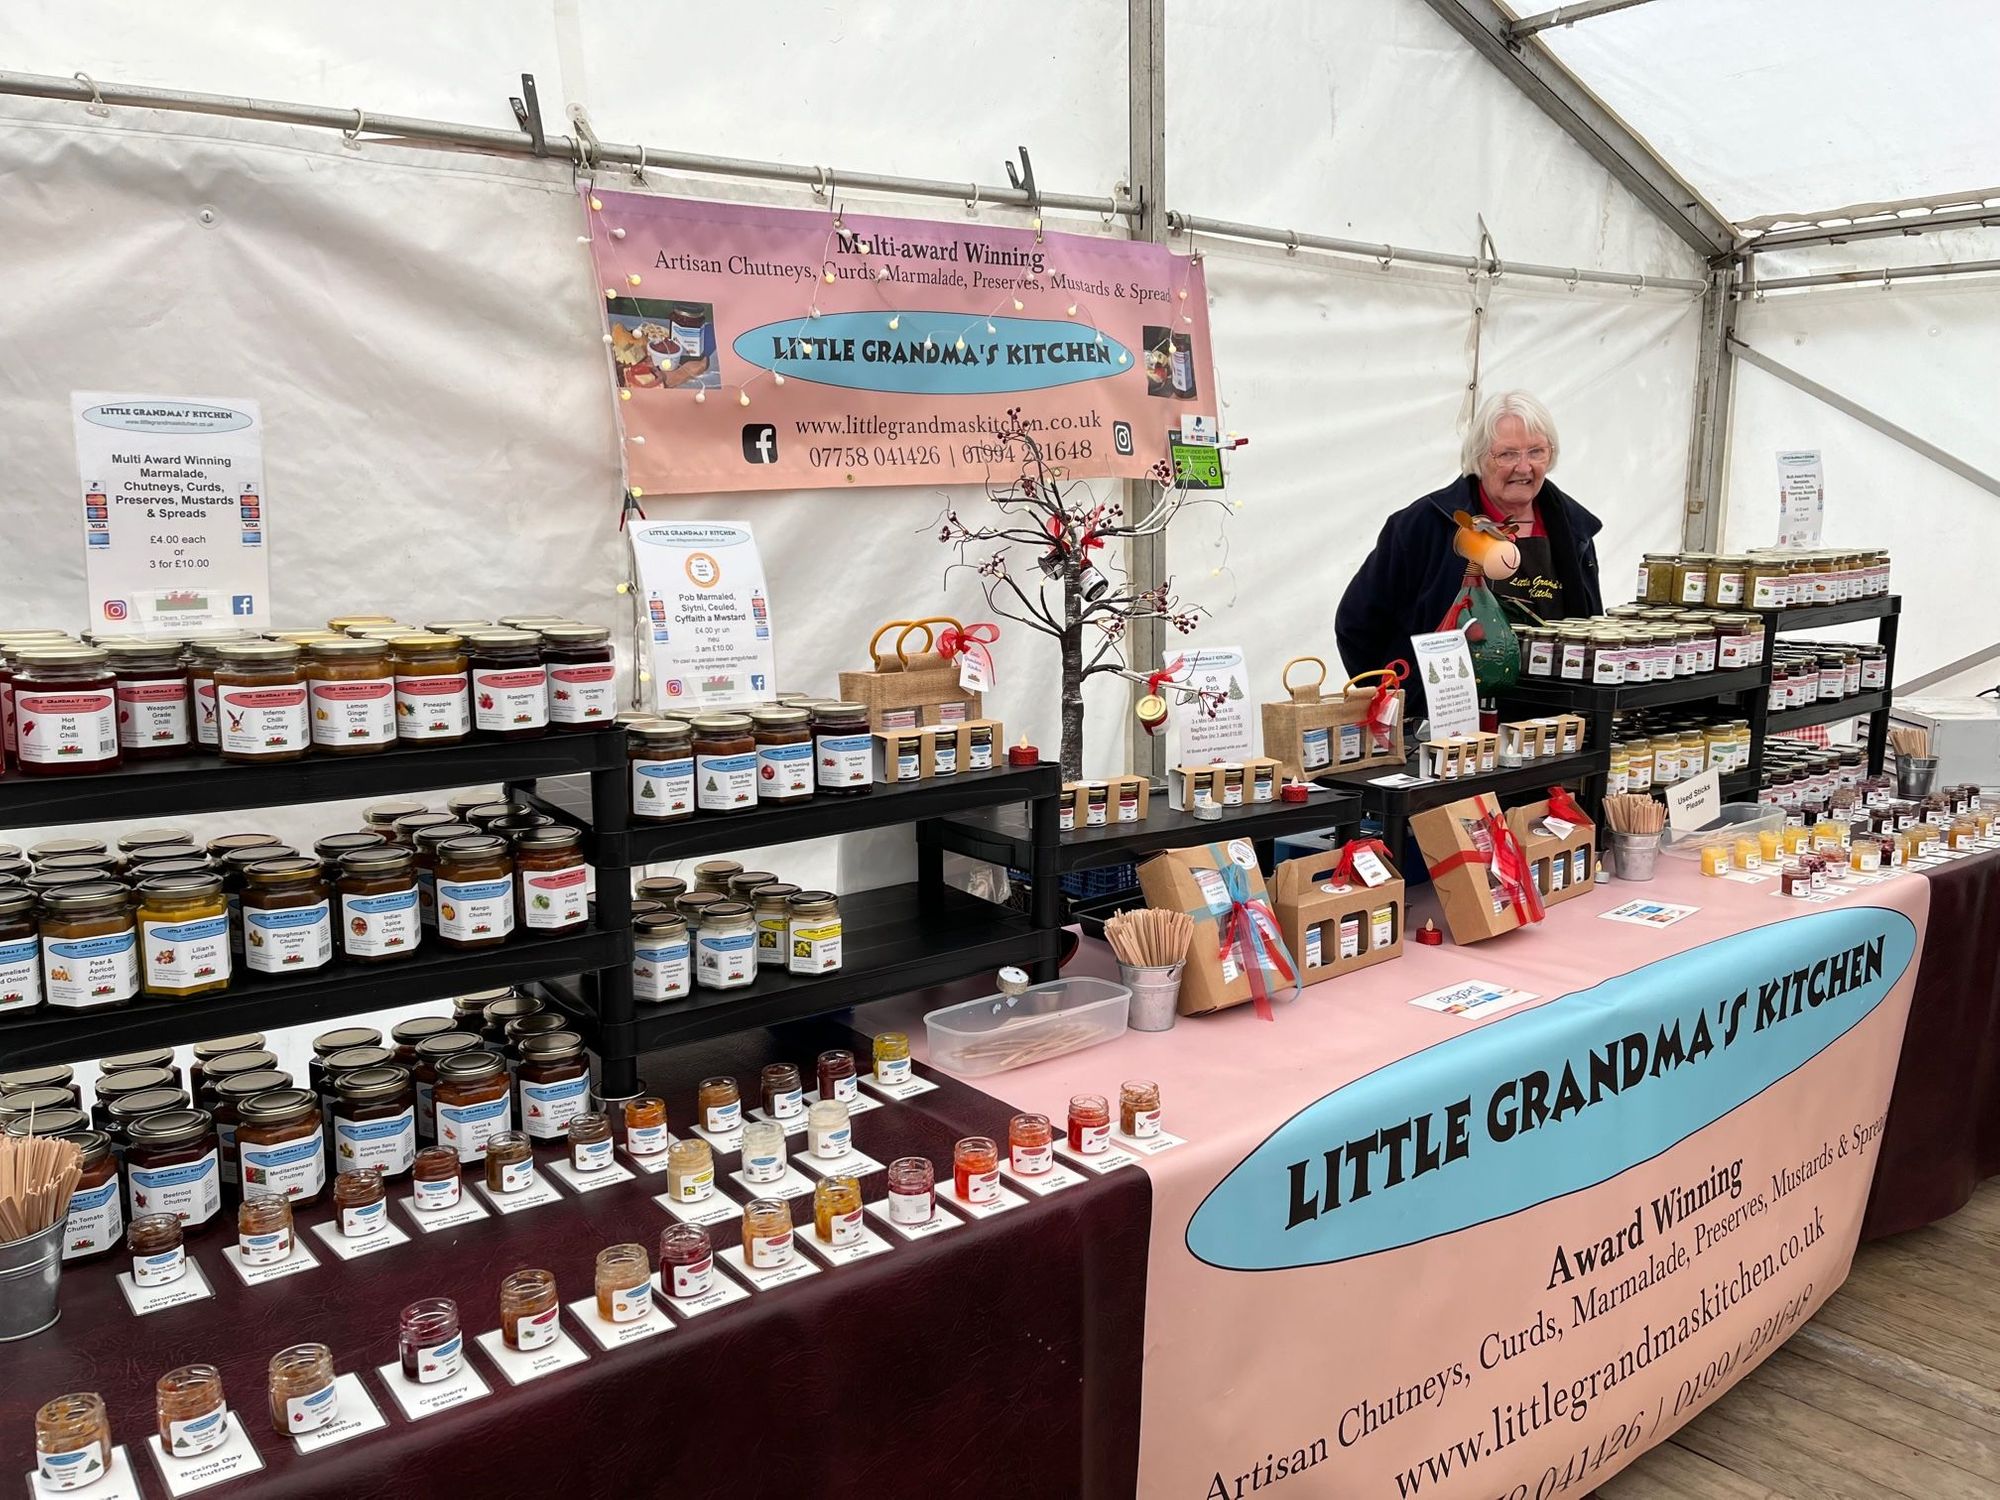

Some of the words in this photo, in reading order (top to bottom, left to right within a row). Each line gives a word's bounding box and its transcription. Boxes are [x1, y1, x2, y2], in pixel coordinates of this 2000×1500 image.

[964, 242, 1045, 274] Winning
[655, 251, 722, 273] Artisan
[728, 256, 817, 283] Chutneys,
[885, 265, 968, 289] Marmalade,
[973, 272, 1045, 293] Preserves,
[1051, 274, 1110, 296] Mustards
[1114, 286, 1125, 298] &
[772, 337, 855, 363] LITTLE
[862, 338, 1000, 367] GRANDMA'S
[1007, 338, 1111, 366] KITCHEN
[133, 409, 189, 418] GRANDMA'S
[192, 411, 232, 419] KITCHEN
[809, 448, 869, 468] 07758
[874, 446, 940, 467] 041426
[963, 444, 1016, 465] 01994
[1022, 440, 1092, 463] 231648
[112, 455, 141, 465] Multi
[144, 455, 181, 465] Award
[184, 456, 231, 467] Winning
[140, 469, 207, 479] Marmalade,
[1211, 468, 1216, 477] 5
[124, 482, 184, 493] Chutneys,
[187, 483, 225, 493] Curds,
[116, 496, 178, 506] Preserves,
[182, 496, 234, 505] Mustards
[147, 510, 155, 518] &
[159, 510, 206, 520] Spreads
[150, 536, 179, 544] £4.00
[182, 536, 206, 544] each
[159, 560, 173, 568] for
[175, 560, 209, 568] £10.00
[679, 594, 694, 602] Pob
[675, 615, 705, 624] Cyffaith
[579, 688, 605, 696] Cranberry
[507, 693, 535, 702] Raspberry
[147, 705, 176, 713] Weapons
[423, 701, 452, 710] Pineapple
[347, 710, 368, 718] Ginger
[262, 724, 289, 732] Chutney
[60, 731, 79, 739] Chilli
[667, 780, 690, 788] Christmas
[1678, 792, 1693, 805] Used
[1694, 784, 1711, 798] Sticks
[1686, 797, 1705, 812] Please
[469, 911, 493, 919] Chutney
[471, 906, 490, 914] Mango
[383, 913, 402, 921] Indian
[385, 920, 402, 928] Spice
[382, 925, 406, 934] Chutney
[272, 930, 311, 940] Ploughman's
[280, 937, 305, 946] Chutney
[192, 944, 215, 954] Lilian's
[190, 951, 217, 961] Piccalilli
[90, 959, 105, 967] Pear
[89, 965, 115, 975] Apricot
[7, 976, 28, 984] Onion
[88, 972, 117, 982] Chutney
[1285, 1095, 1472, 1232] LITTLE
[1487, 993, 1748, 1145] GRANDMA'S
[1754, 935, 1886, 1033] KITCHEN
[375, 1147, 397, 1155] Chutney
[269, 1162, 313, 1177] Mediterranean
[279, 1171, 305, 1182] Chutney
[163, 1189, 192, 1199] Beetroot
[164, 1196, 191, 1206] Chutney
[79, 1213, 104, 1224] Tomato
[1547, 1205, 1645, 1292] Award
[1651, 1155, 1745, 1239] Winning
[67, 1223, 95, 1233] Chutney
[248, 1258, 310, 1278] Mediterranean
[264, 1265, 301, 1278] Chutney
[143, 1300, 169, 1310] Spicy
[170, 1292, 197, 1305] Apple
[150, 1291, 187, 1303] Grumpe
[685, 1289, 727, 1307] Raspberry
[1206, 1437, 1329, 1500] Artisan
[1337, 1359, 1472, 1450] Chutneys,
[1479, 1309, 1564, 1373] Curds,
[1570, 1243, 1692, 1329] Marmalade,
[1694, 1191, 1769, 1258] Preserves,
[1771, 1142, 1834, 1200] Mustards
[1838, 1134, 1849, 1159] &
[618, 1322, 647, 1336] Mango
[619, 1325, 656, 1342] Chutney
[1395, 1207, 1826, 1499] www.littlegrandmaskitchen.co.uk
[418, 1385, 468, 1406] Cranberry
[432, 1394, 463, 1408] Sauce
[316, 1420, 362, 1440] Humbug
[180, 1463, 219, 1479] Boxing
[220, 1453, 242, 1467] Day
[191, 1462, 238, 1482] Chutney
